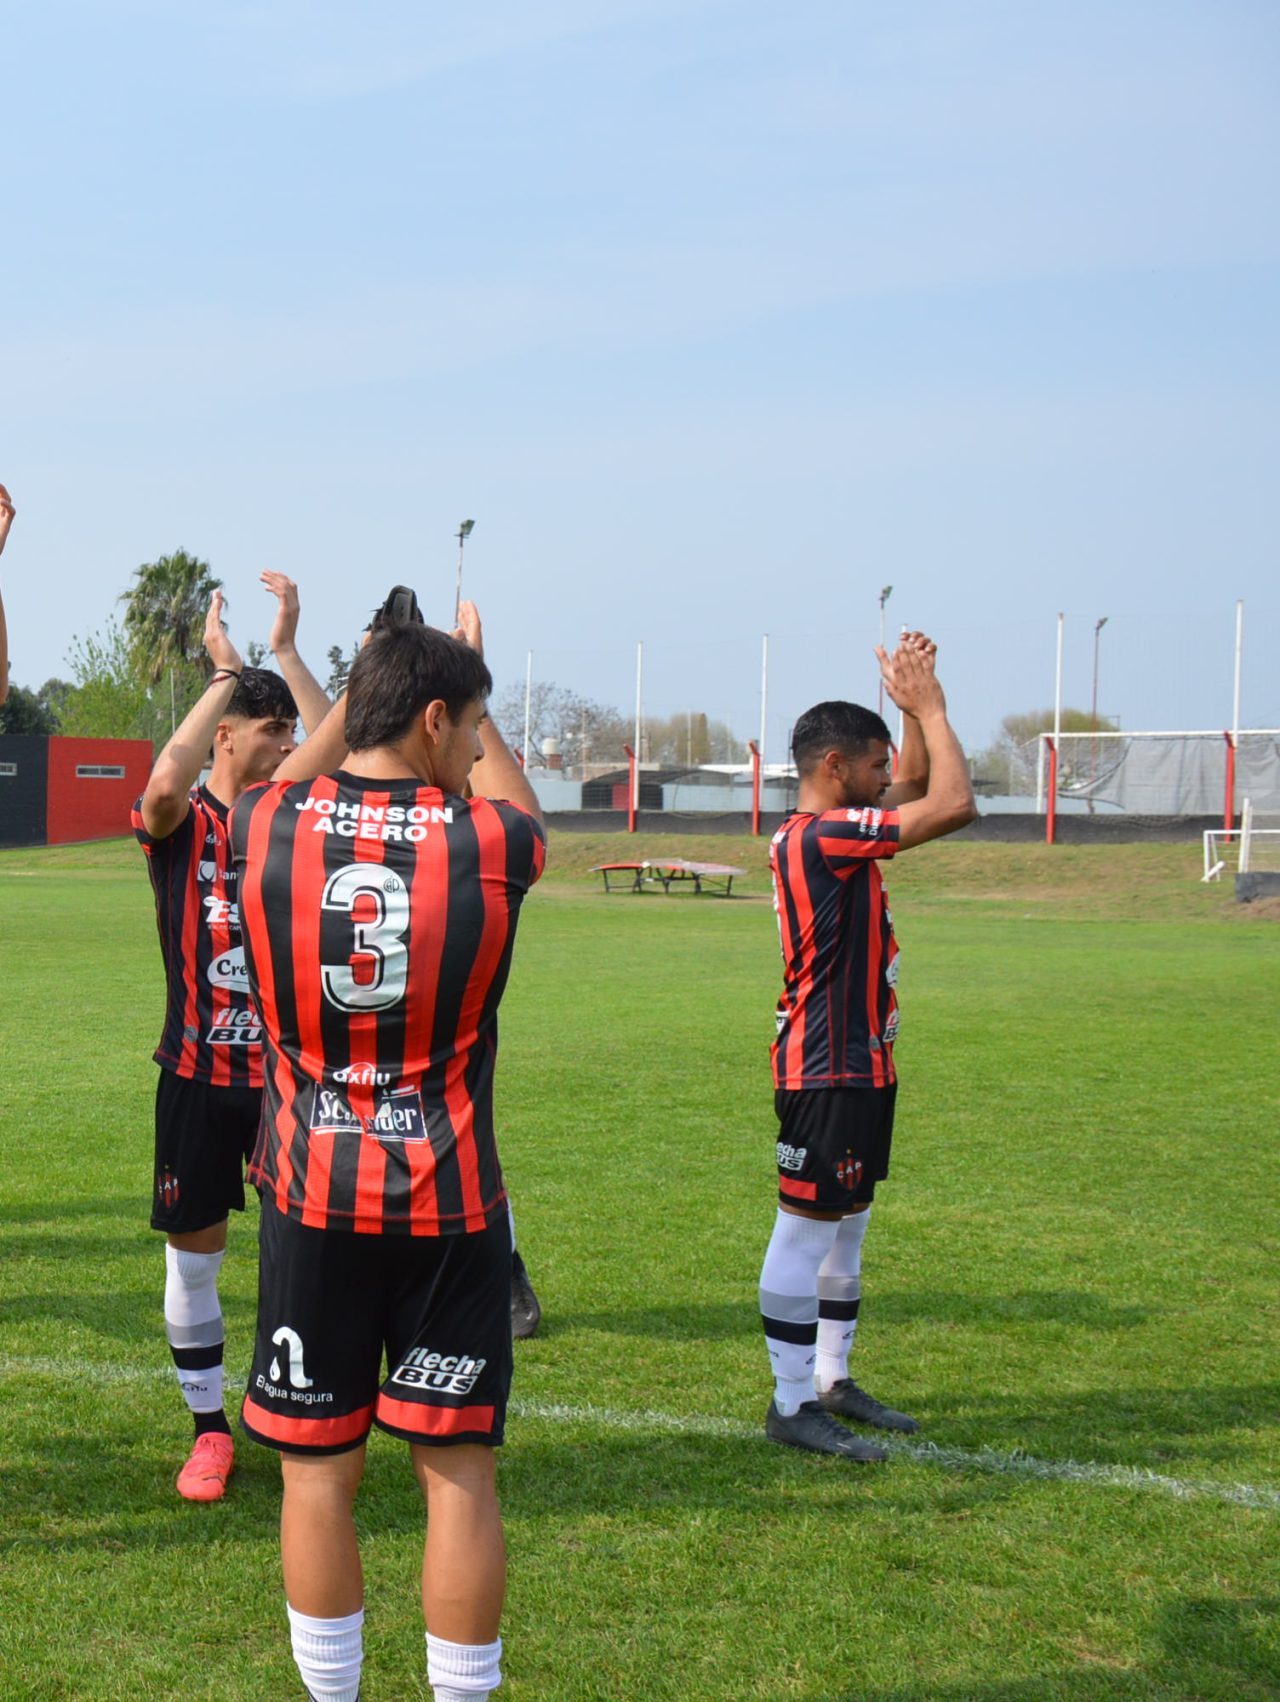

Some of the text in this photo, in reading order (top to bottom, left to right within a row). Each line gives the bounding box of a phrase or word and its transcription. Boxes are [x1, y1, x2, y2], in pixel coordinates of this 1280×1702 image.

[295, 797, 454, 824] JOHNSON
[312, 816, 428, 842] ACERO
[320, 862, 411, 1013] 3
[207, 1027, 262, 1043] BU
[776, 1142, 808, 1159] echa
[777, 1154, 805, 1171] US
[404, 1347, 488, 1375] flecha
[256, 1374, 334, 1405] El agua segura
[392, 1365, 479, 1395] BUS
